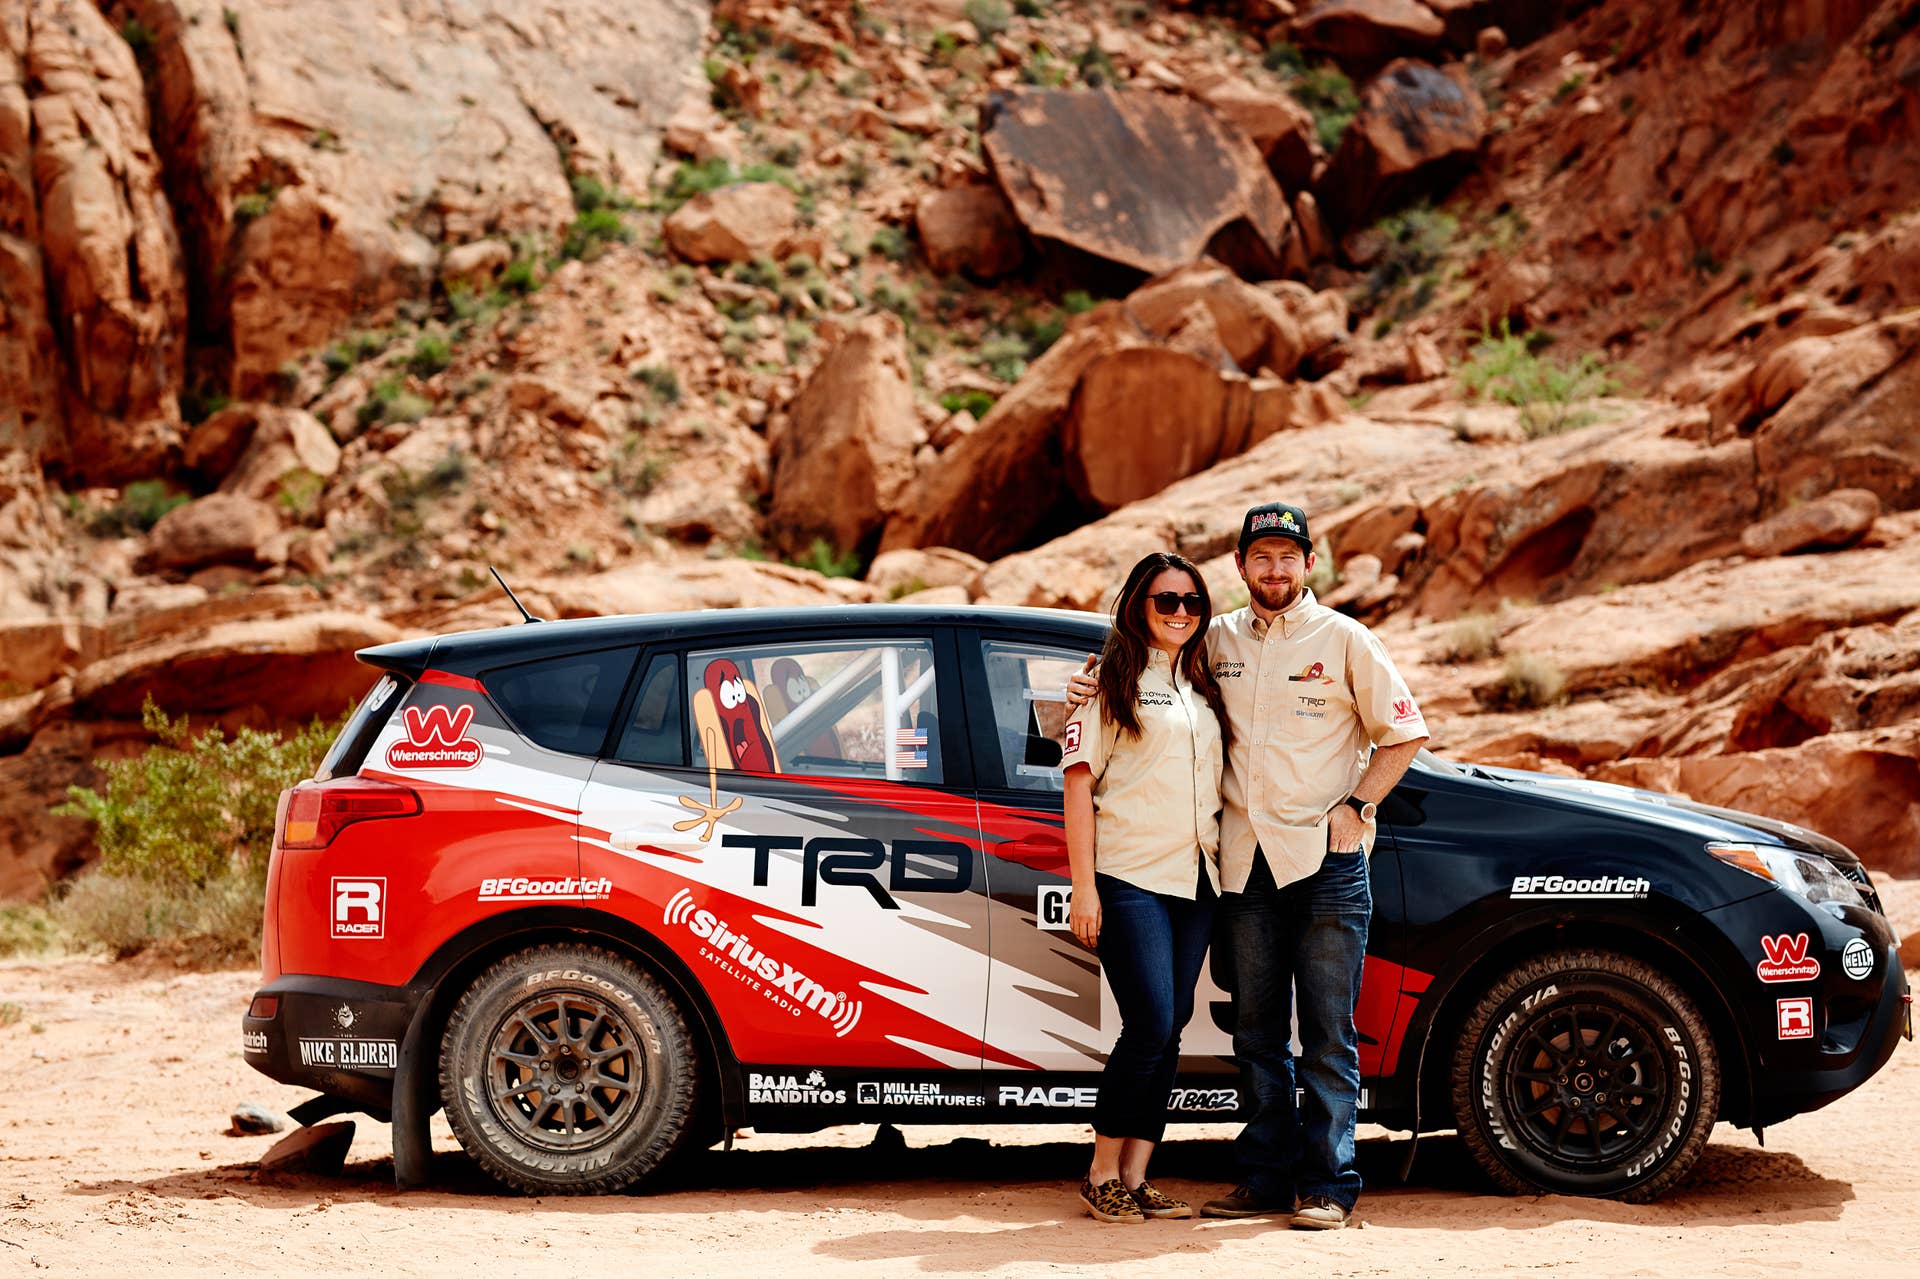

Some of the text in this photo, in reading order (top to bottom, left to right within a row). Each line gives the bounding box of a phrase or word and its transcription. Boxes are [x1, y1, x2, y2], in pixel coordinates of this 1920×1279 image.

[1298, 696, 1326, 707] TRD
[391, 749, 479, 763] Wienerschnitzel
[721, 834, 973, 910] TRD
[479, 877, 613, 895] BFGoodrich
[1511, 876, 1650, 892] BFGoodrich
[336, 882, 381, 921] R
[1043, 891, 1072, 924] G
[336, 923, 380, 933] RACER
[1845, 948, 1874, 968] HELLA
[1760, 965, 1817, 976] Wienerschnitzel
[698, 947, 802, 1017] SATELLITE RADIO
[526, 970, 662, 1054] BFGoodrich
[1780, 1001, 1810, 1028] R
[1782, 1028, 1810, 1036] RACER
[300, 1041, 398, 1069] MIKE ELDRED
[1482, 984, 1559, 1150] All-Terrain T/A
[749, 1073, 800, 1091] BAJA
[883, 1082, 940, 1095] MILLEN
[749, 1089, 847, 1104] BANDITOS
[883, 1095, 986, 1107] ADVENTURES
[999, 1086, 1099, 1107] RACE
[1180, 1089, 1239, 1111] BAGZ
[1627, 1026, 1691, 1178] BFGoodrich
